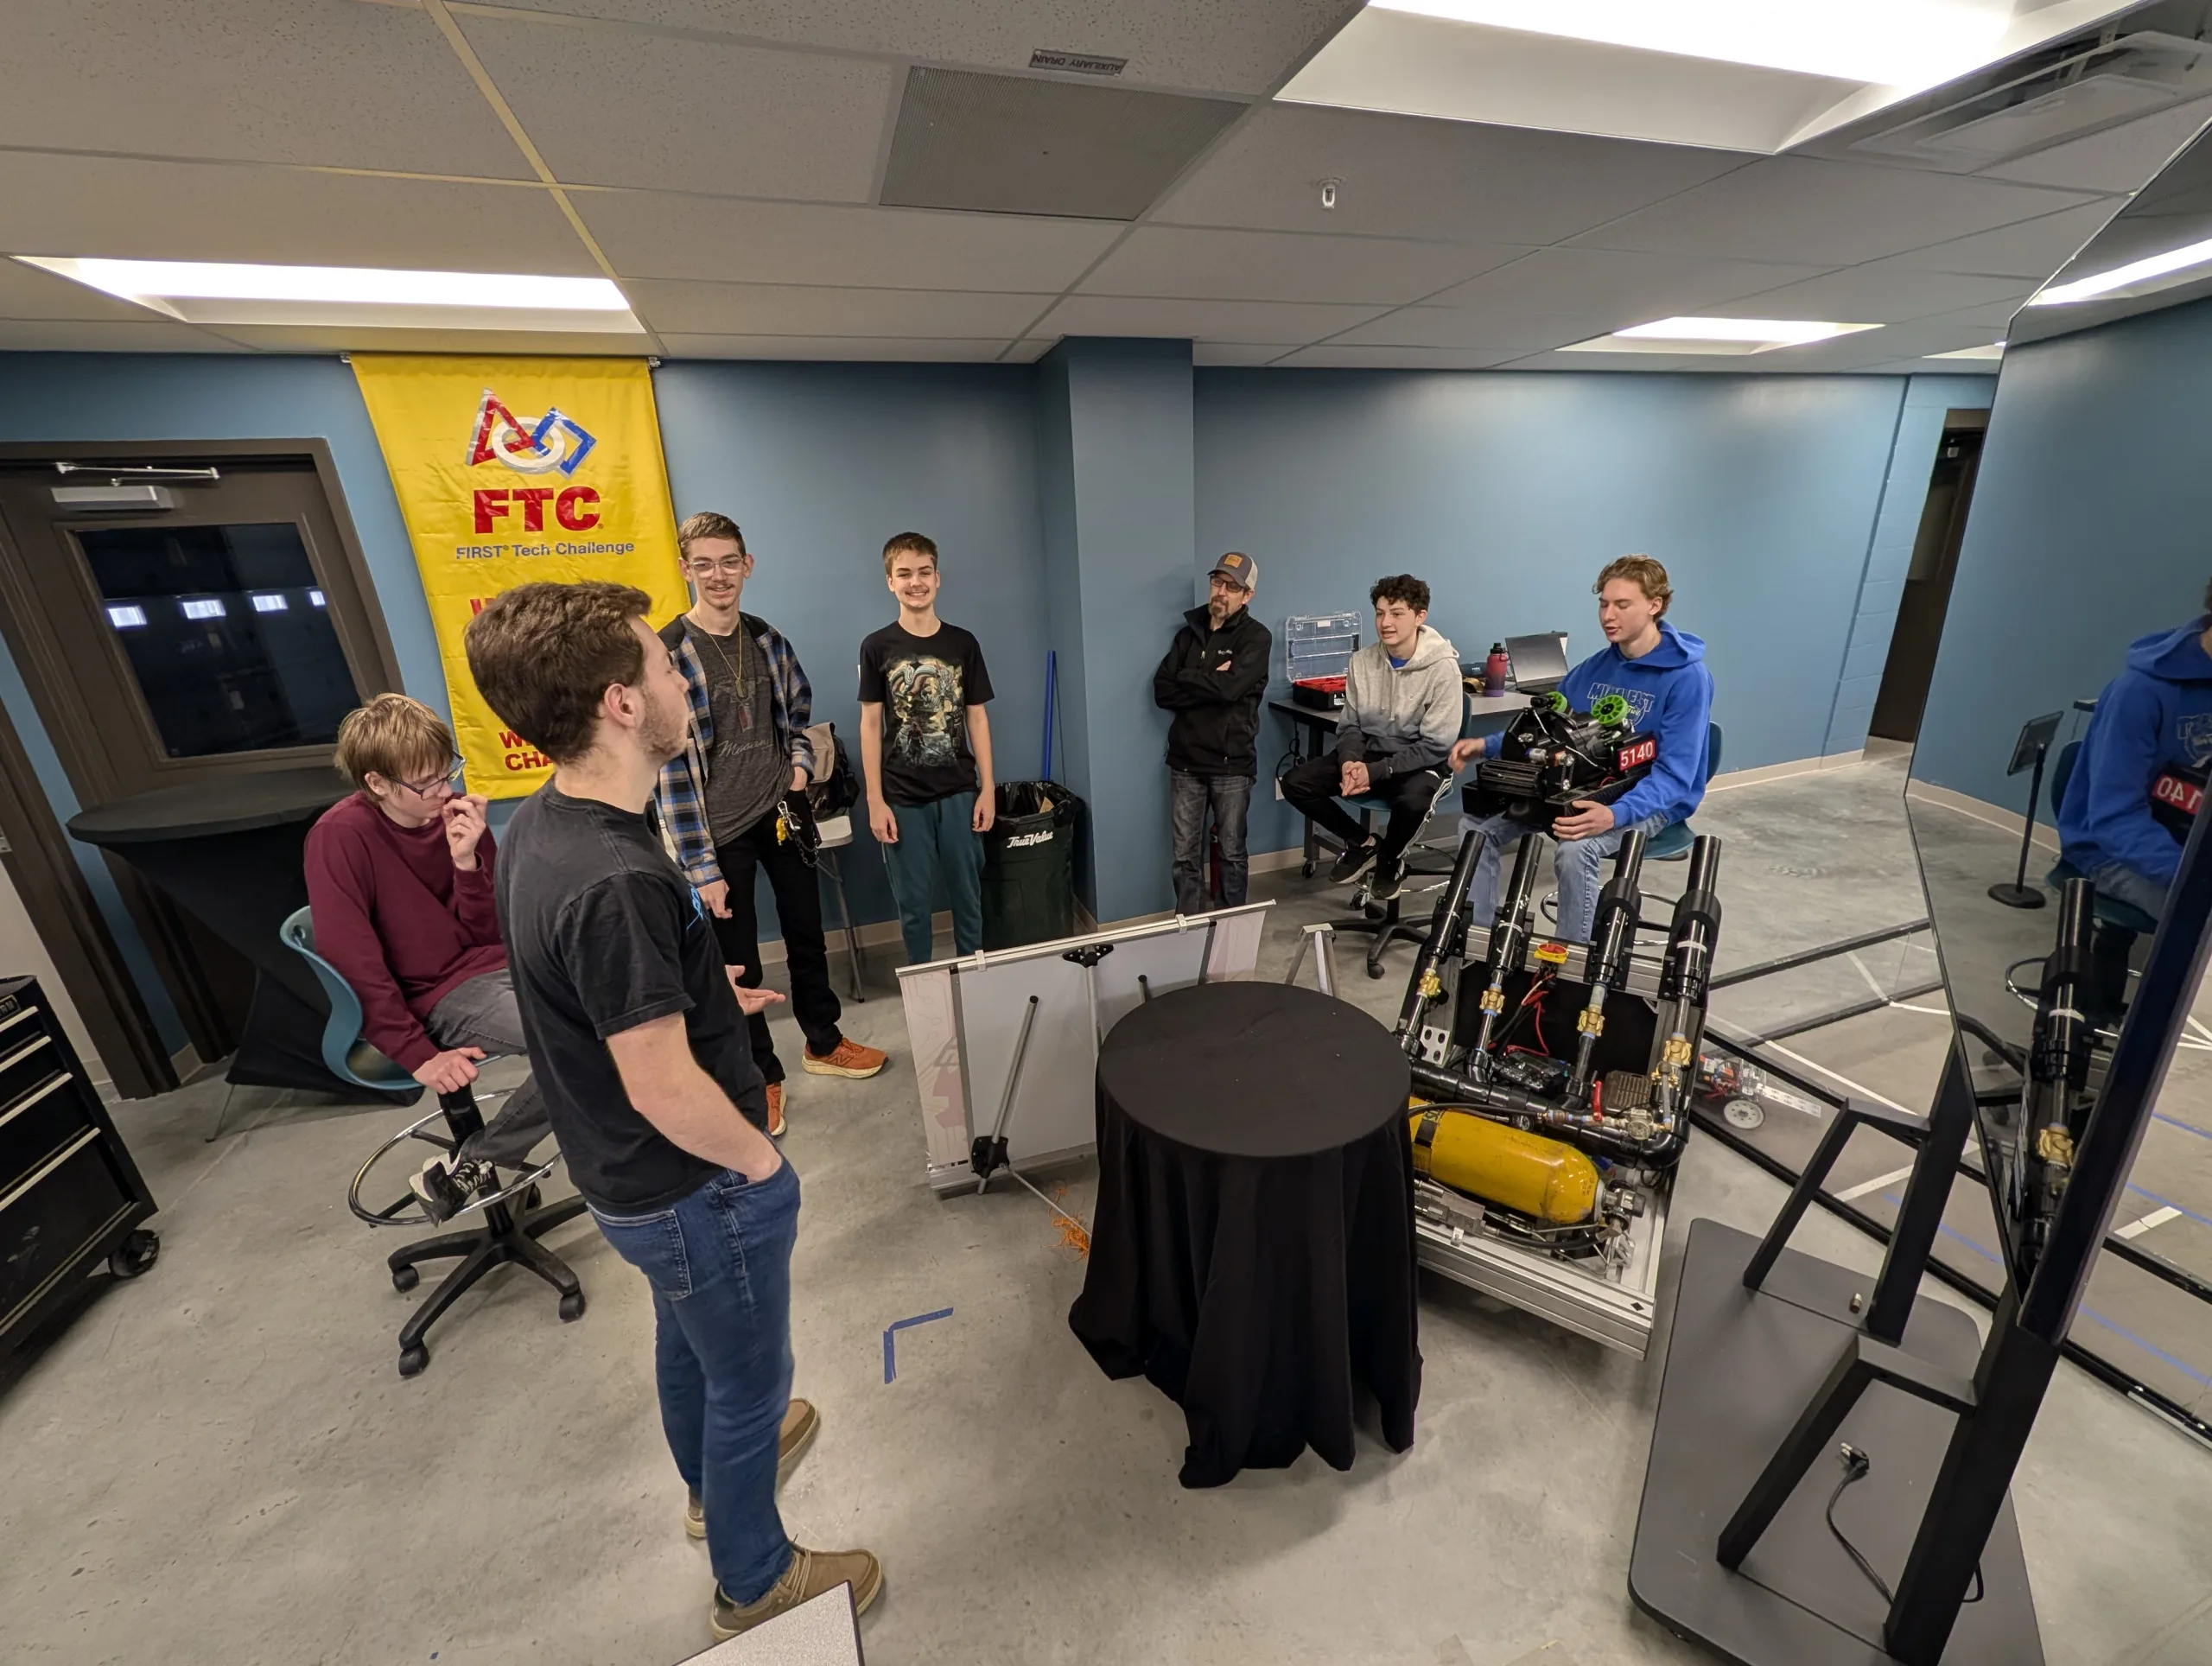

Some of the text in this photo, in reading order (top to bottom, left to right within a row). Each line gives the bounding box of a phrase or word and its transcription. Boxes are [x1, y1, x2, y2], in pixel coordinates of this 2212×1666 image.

[1033, 54, 1123, 72] AUXILIARY DRAIN
[474, 486, 601, 534] FTC
[512, 544, 550, 556] Tech
[556, 541, 634, 556] Challenge
[1621, 741, 1654, 767] 5140
